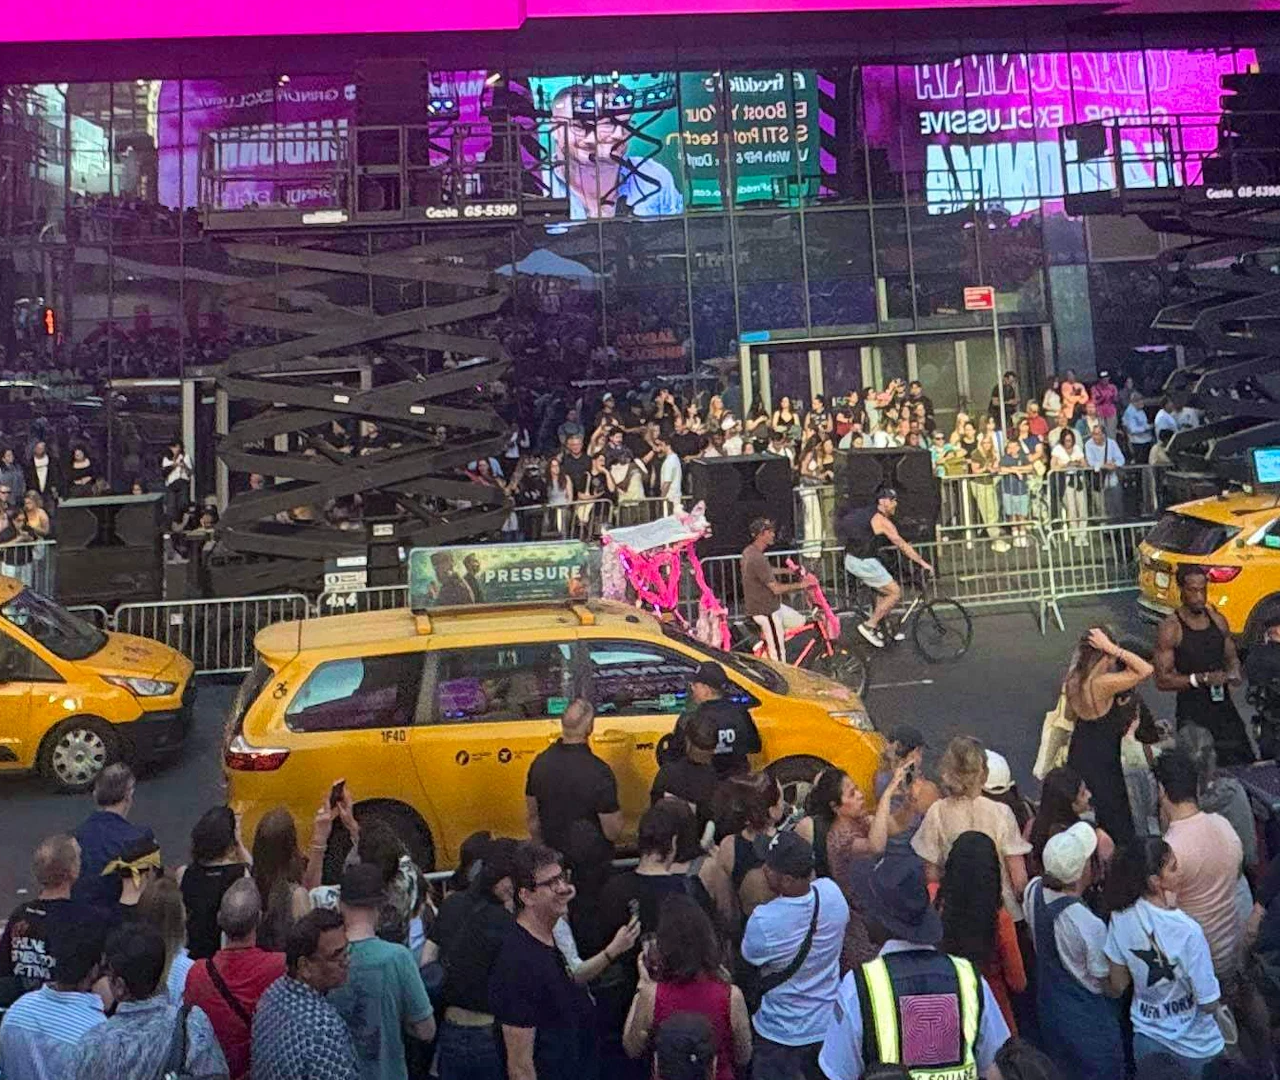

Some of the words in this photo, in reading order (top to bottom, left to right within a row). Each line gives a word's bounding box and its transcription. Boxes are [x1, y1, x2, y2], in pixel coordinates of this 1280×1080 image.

[426, 206, 459, 218] Genie
[464, 204, 518, 217] GS-5390
[485, 565, 581, 584] PRESSURE
[326, 592, 358, 607] 4x4
[1139, 1002, 1160, 1018] NEW
[1163, 994, 1194, 1016] YORK
